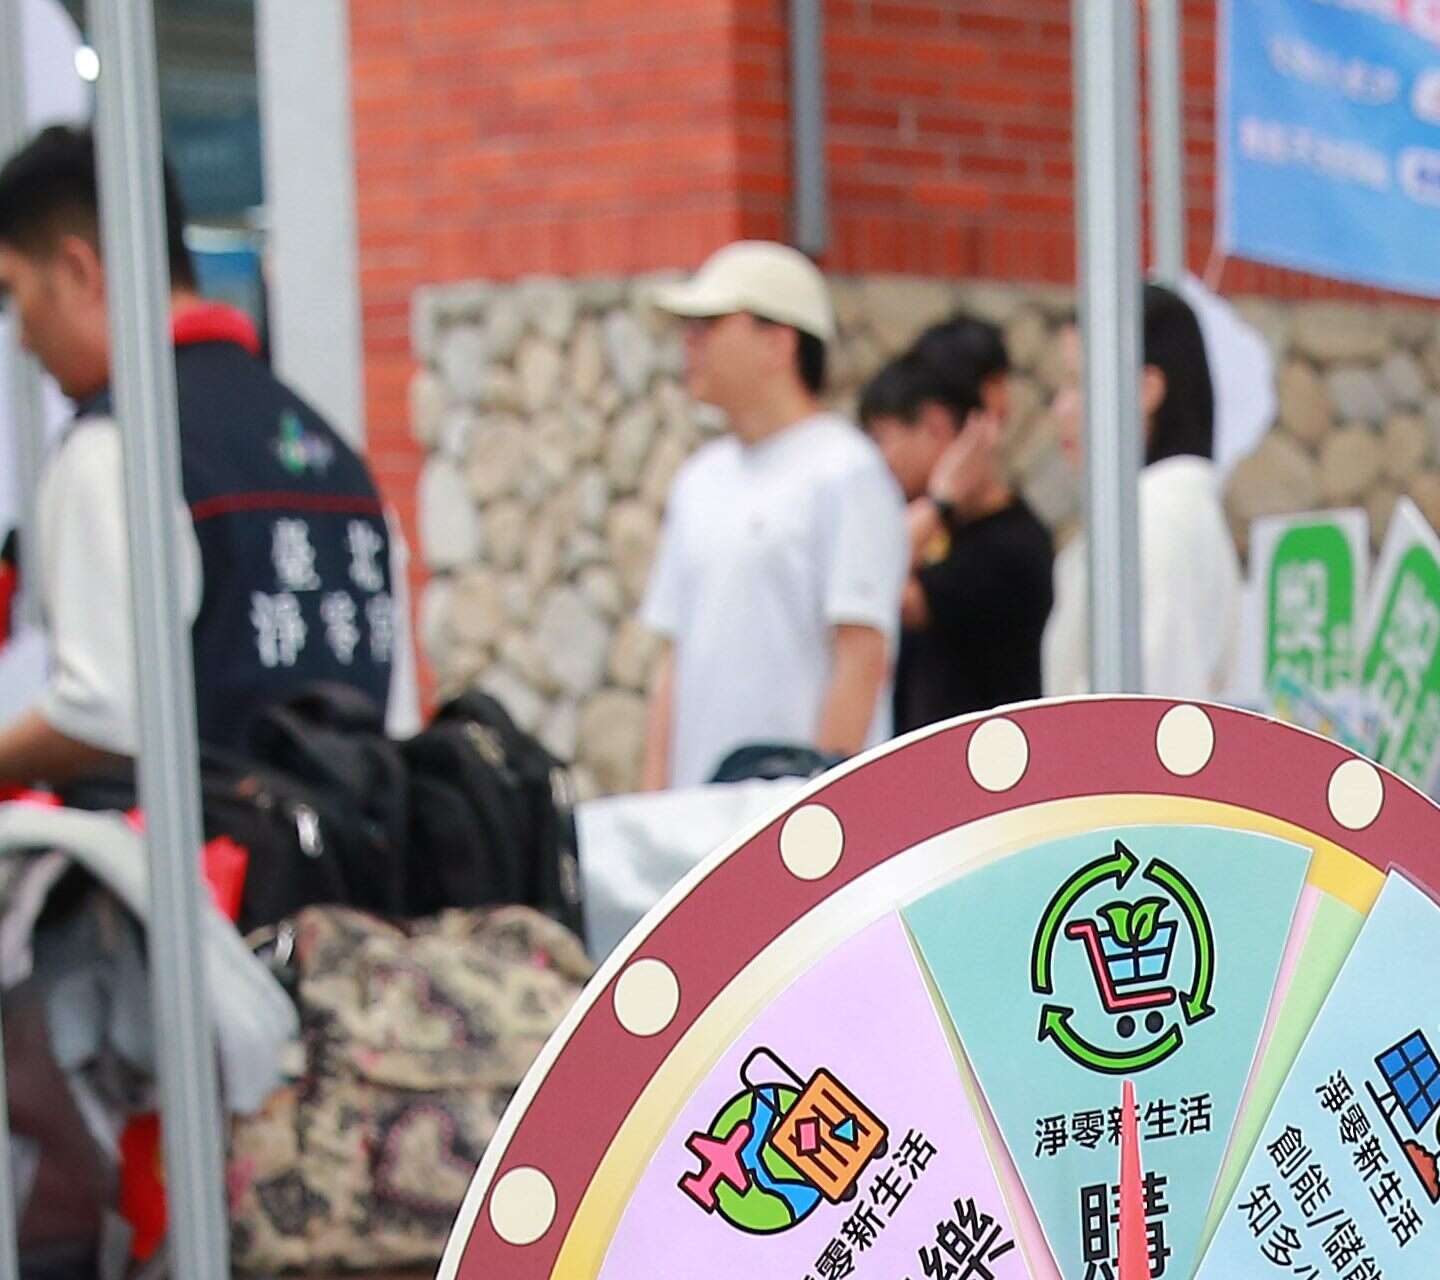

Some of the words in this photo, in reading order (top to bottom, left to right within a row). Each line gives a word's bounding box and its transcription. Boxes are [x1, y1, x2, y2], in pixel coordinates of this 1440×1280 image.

[1034, 1092, 1213, 1158] 淨零新生活
[1314, 1070, 1424, 1249] 淨零新生活
